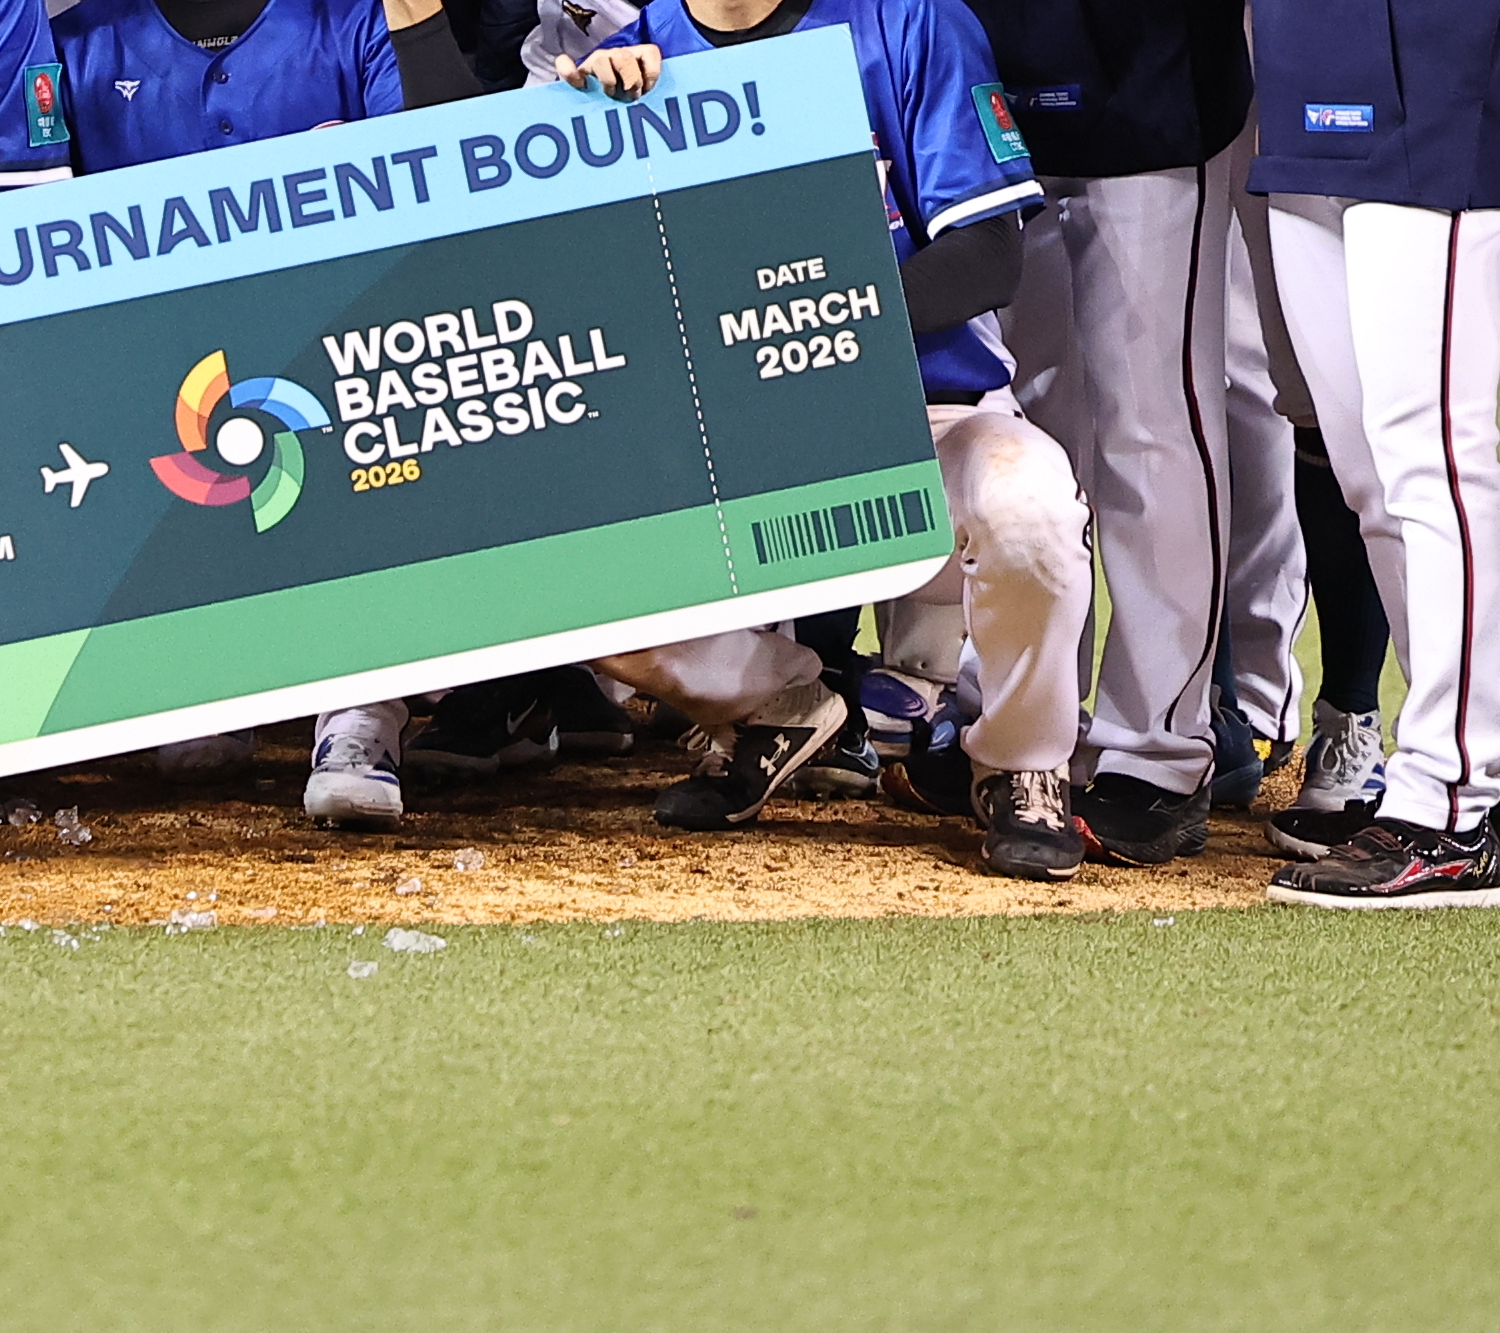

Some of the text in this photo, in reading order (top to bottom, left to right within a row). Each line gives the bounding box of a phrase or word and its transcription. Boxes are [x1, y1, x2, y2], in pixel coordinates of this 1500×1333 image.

[459, 81, 767, 193] BOUND!
[756, 257, 826, 290] DATE
[322, 299, 534, 377] WORLD
[719, 284, 881, 347] MARCH
[334, 327, 626, 423] BASEBALL
[755, 331, 861, 381] 2026
[342, 380, 588, 466] CLASSIC
[351, 459, 421, 493] 2026
